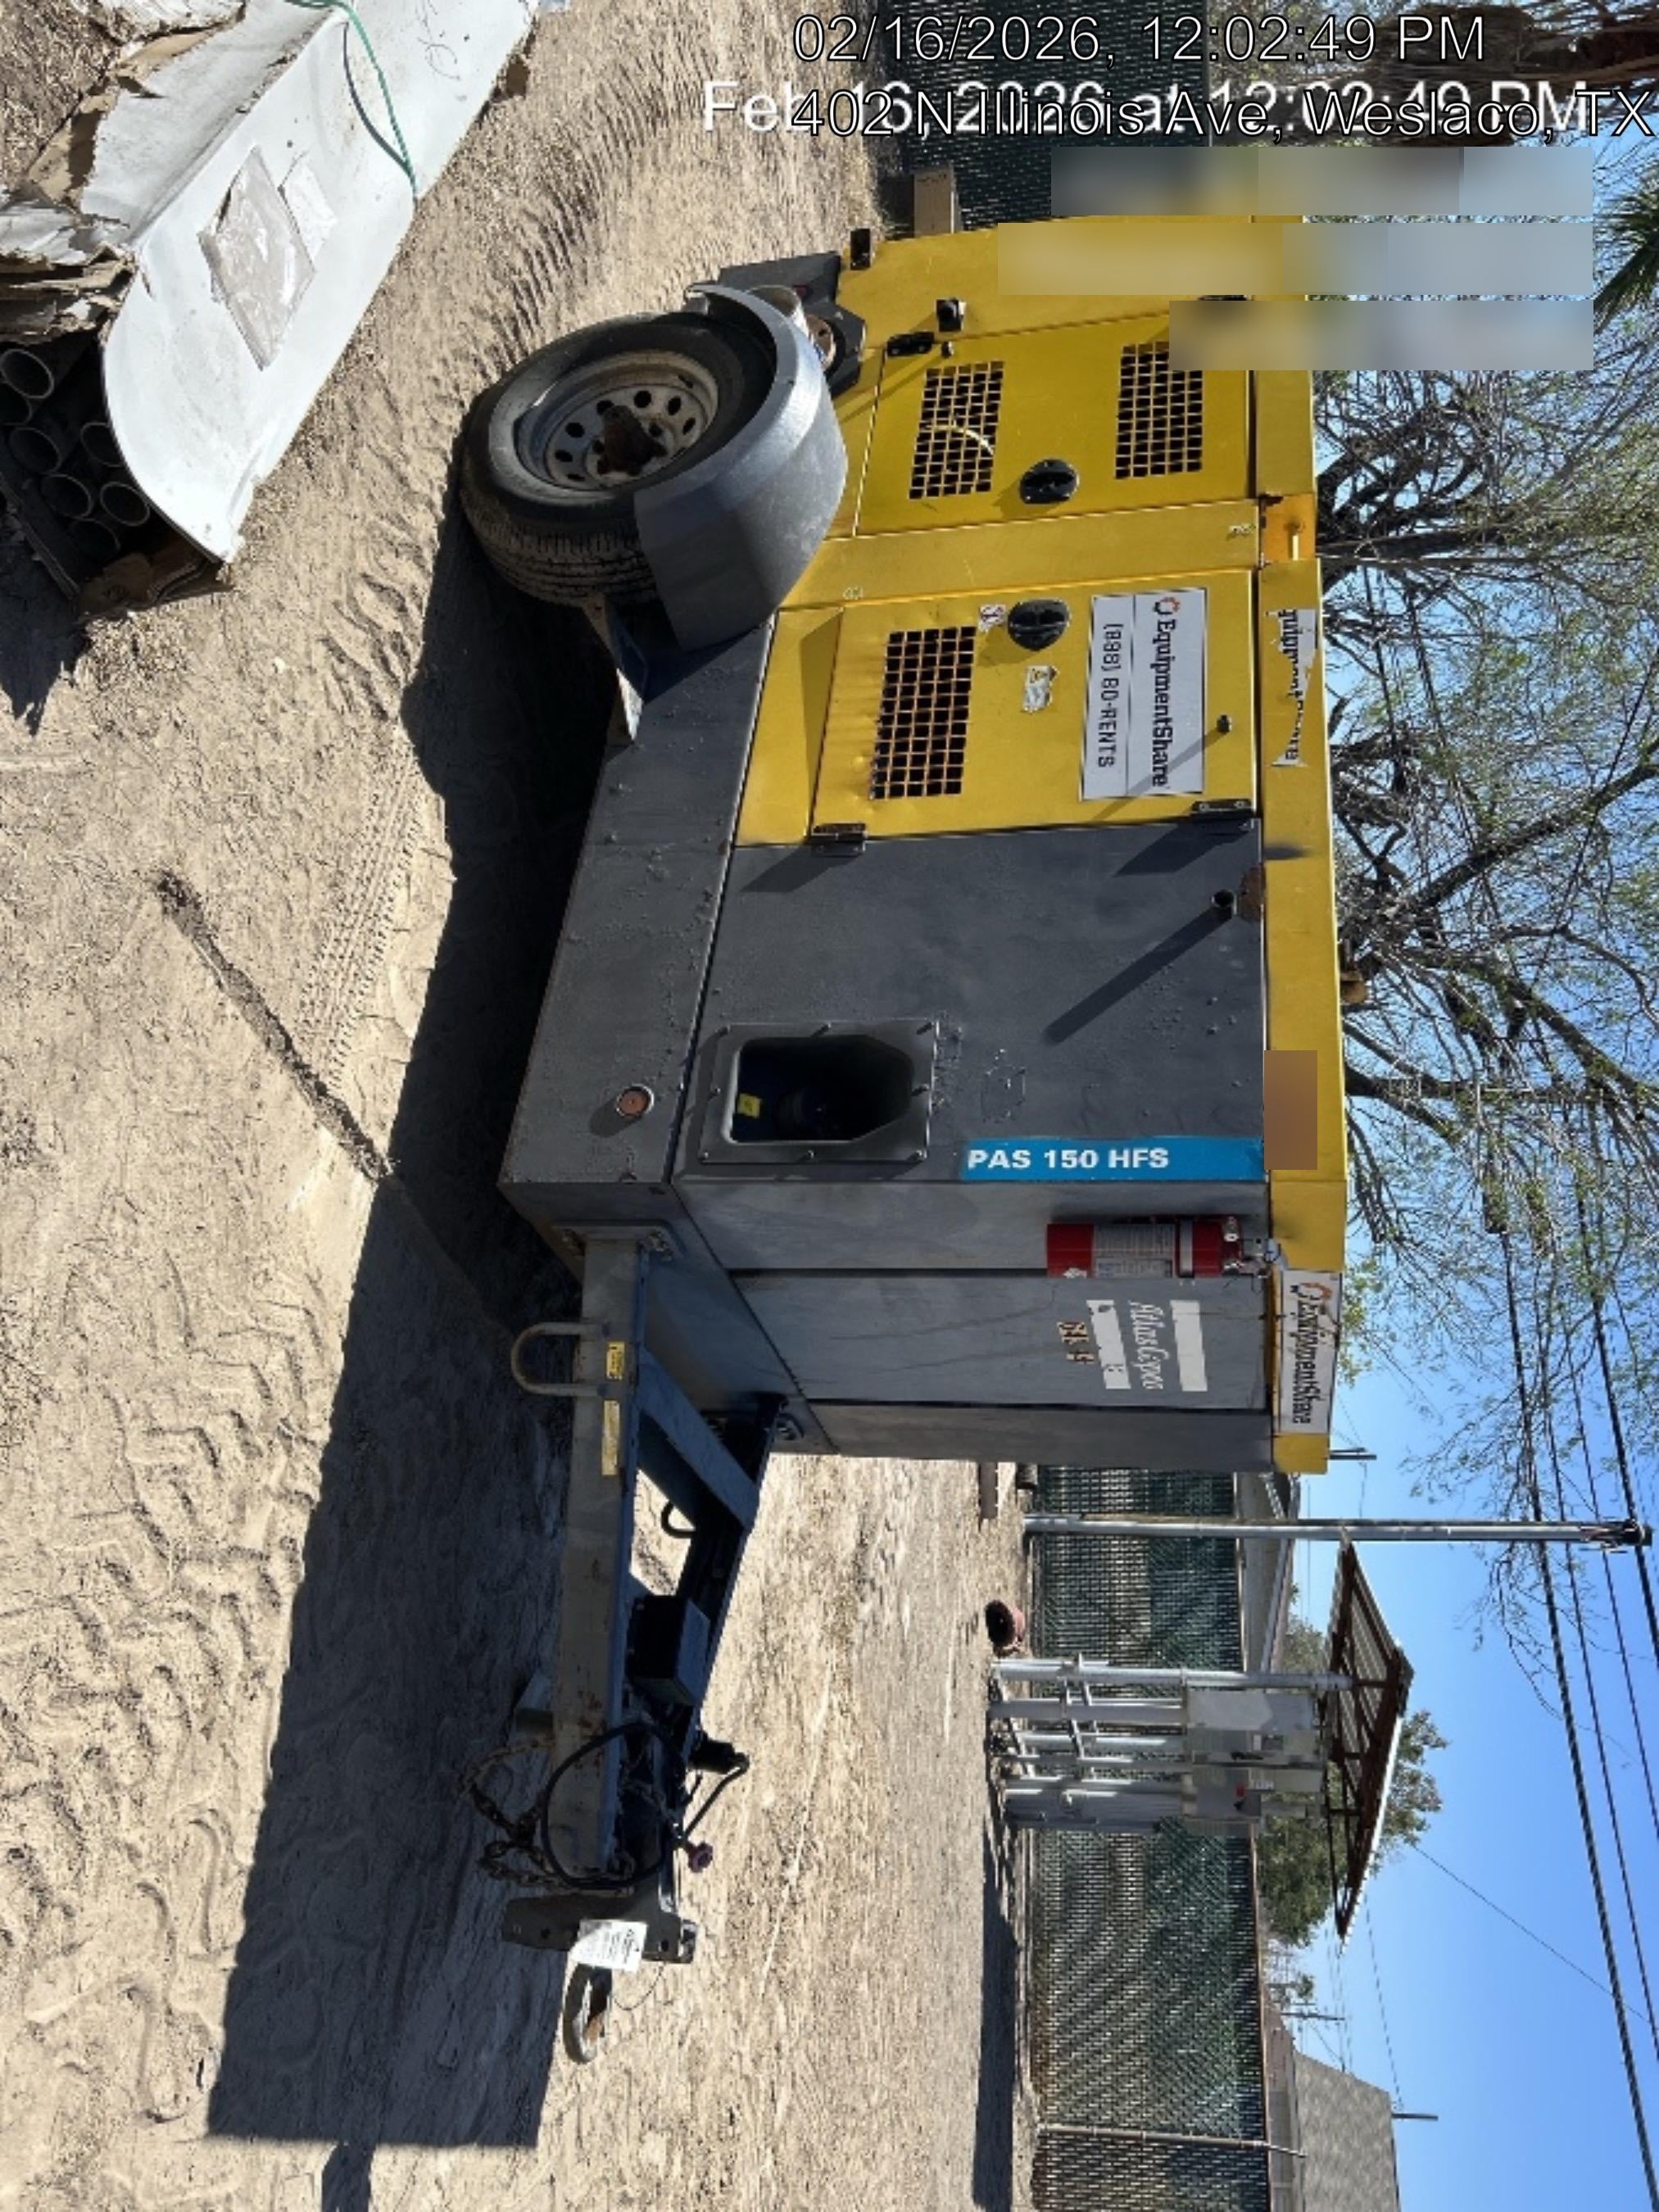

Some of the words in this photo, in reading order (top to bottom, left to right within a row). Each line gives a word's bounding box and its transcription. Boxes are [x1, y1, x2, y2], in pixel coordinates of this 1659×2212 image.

[1150, 619, 1177, 788] EquipmentShare
[968, 1149, 1031, 1169] PAS
[1043, 1149, 1099, 1169] 150
[1107, 1147, 1169, 1169] HFS
